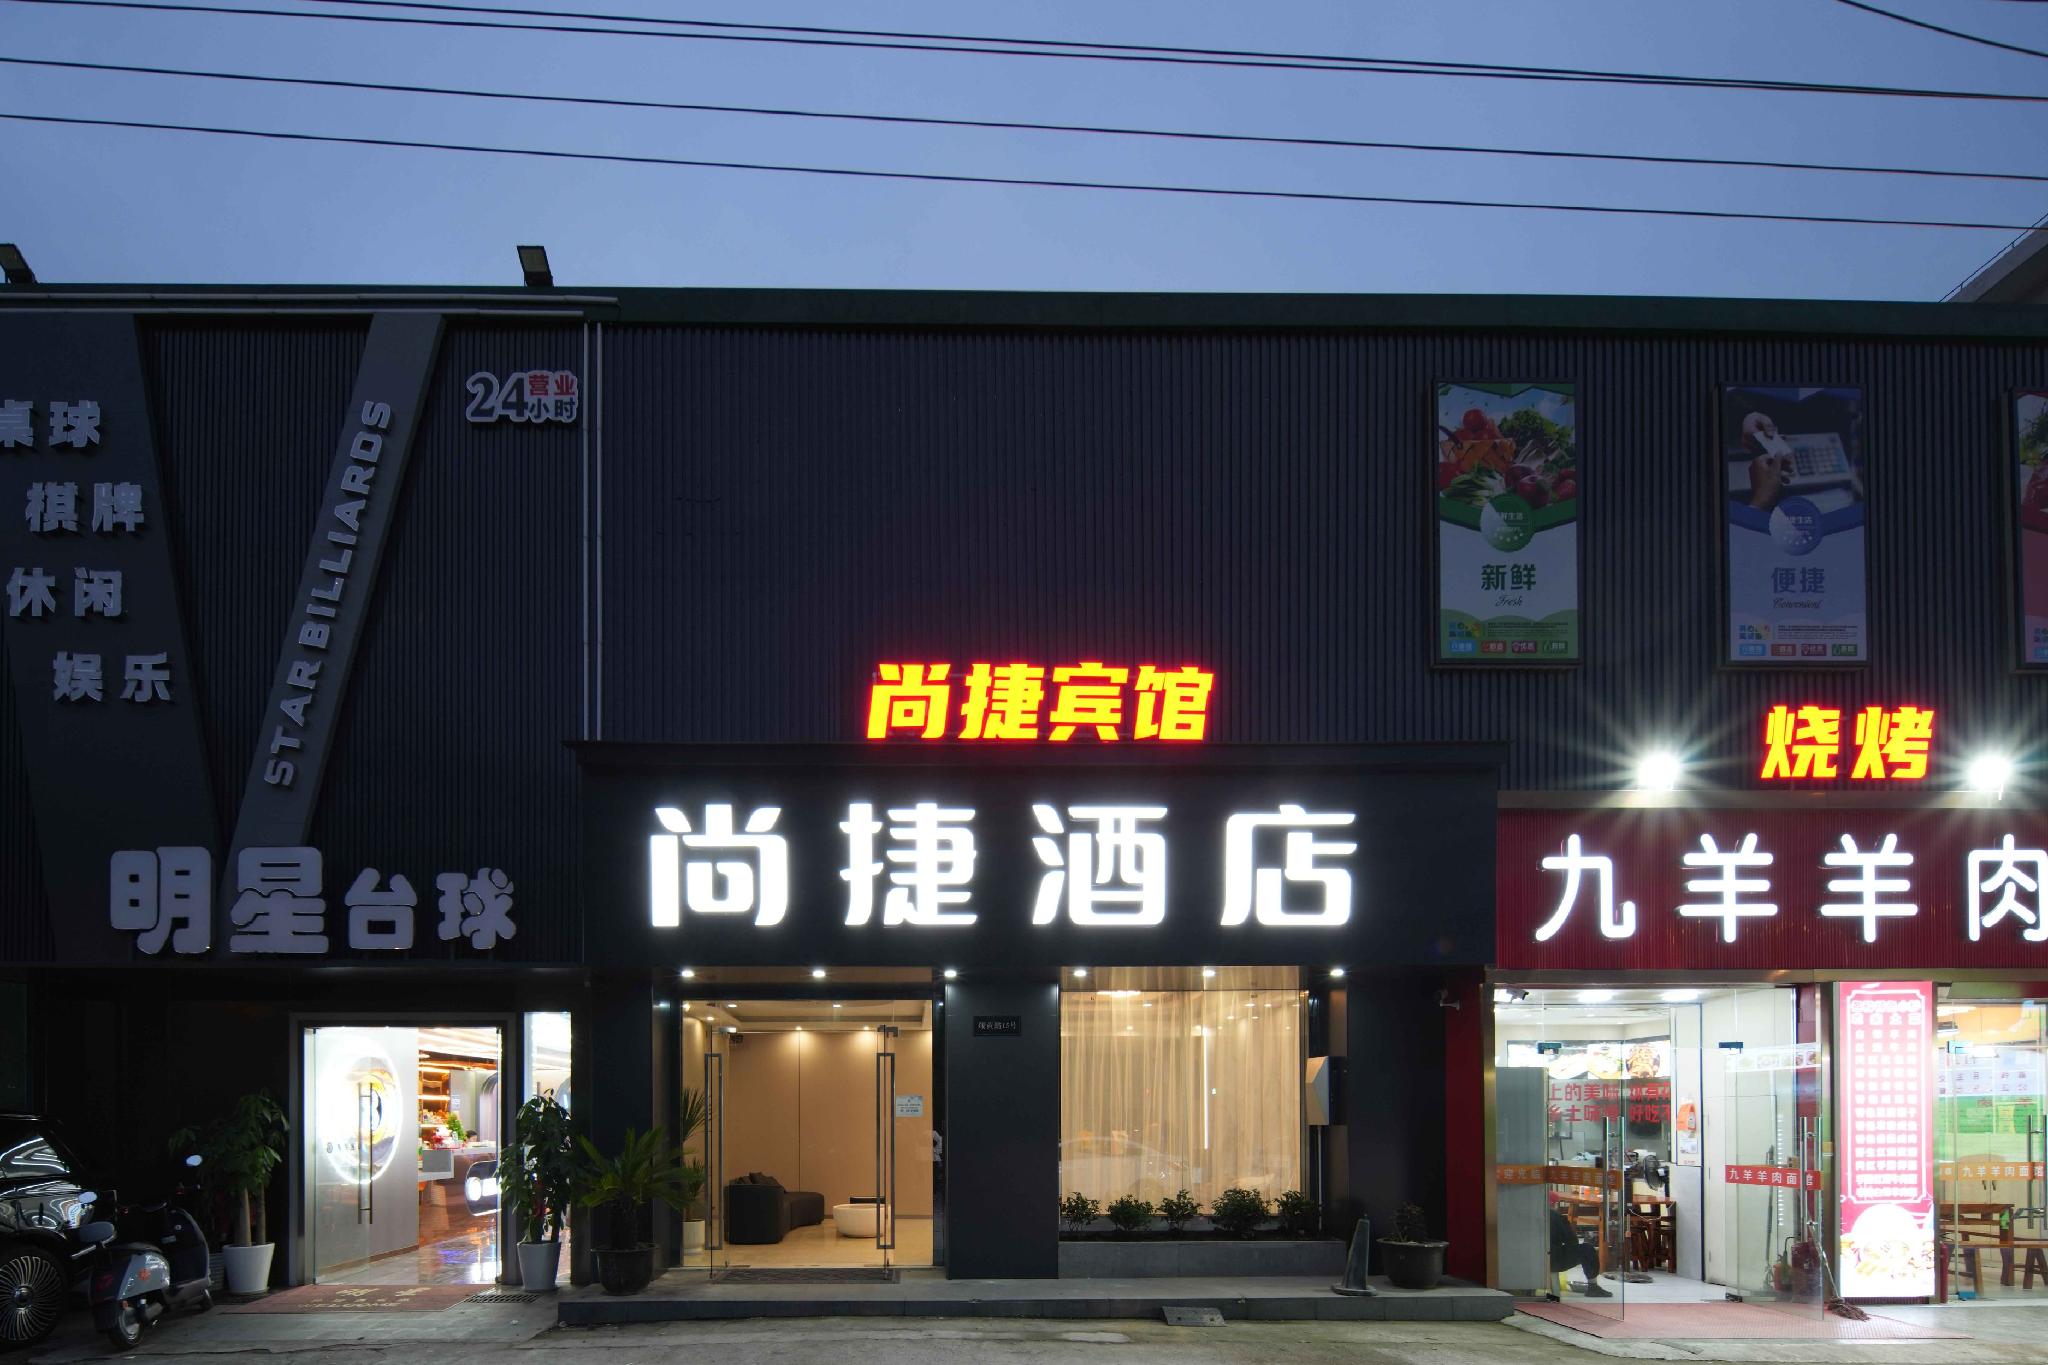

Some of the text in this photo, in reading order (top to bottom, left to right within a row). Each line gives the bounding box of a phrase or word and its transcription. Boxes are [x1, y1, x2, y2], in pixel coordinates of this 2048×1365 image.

[467, 373, 529, 421] 24
[529, 374, 576, 397] 营业
[529, 397, 576, 420] 小时
[0, 400, 100, 448] 桌球
[25, 481, 144, 532] 棋牌
[6, 567, 122, 617] 休闲
[264, 400, 391, 787] STAR BILLIARDS
[1481, 563, 1537, 592] 新鲜
[1770, 566, 1825, 595] 便捷
[53, 652, 170, 702] 娱乐
[866, 663, 1214, 742] 尚捷宾馆
[1761, 705, 1935, 779] 烧烤
[650, 803, 1358, 928] 尚捷酒店
[1535, 833, 2048, 942] 九羊羊肉
[110, 846, 516, 954] 明星台球
